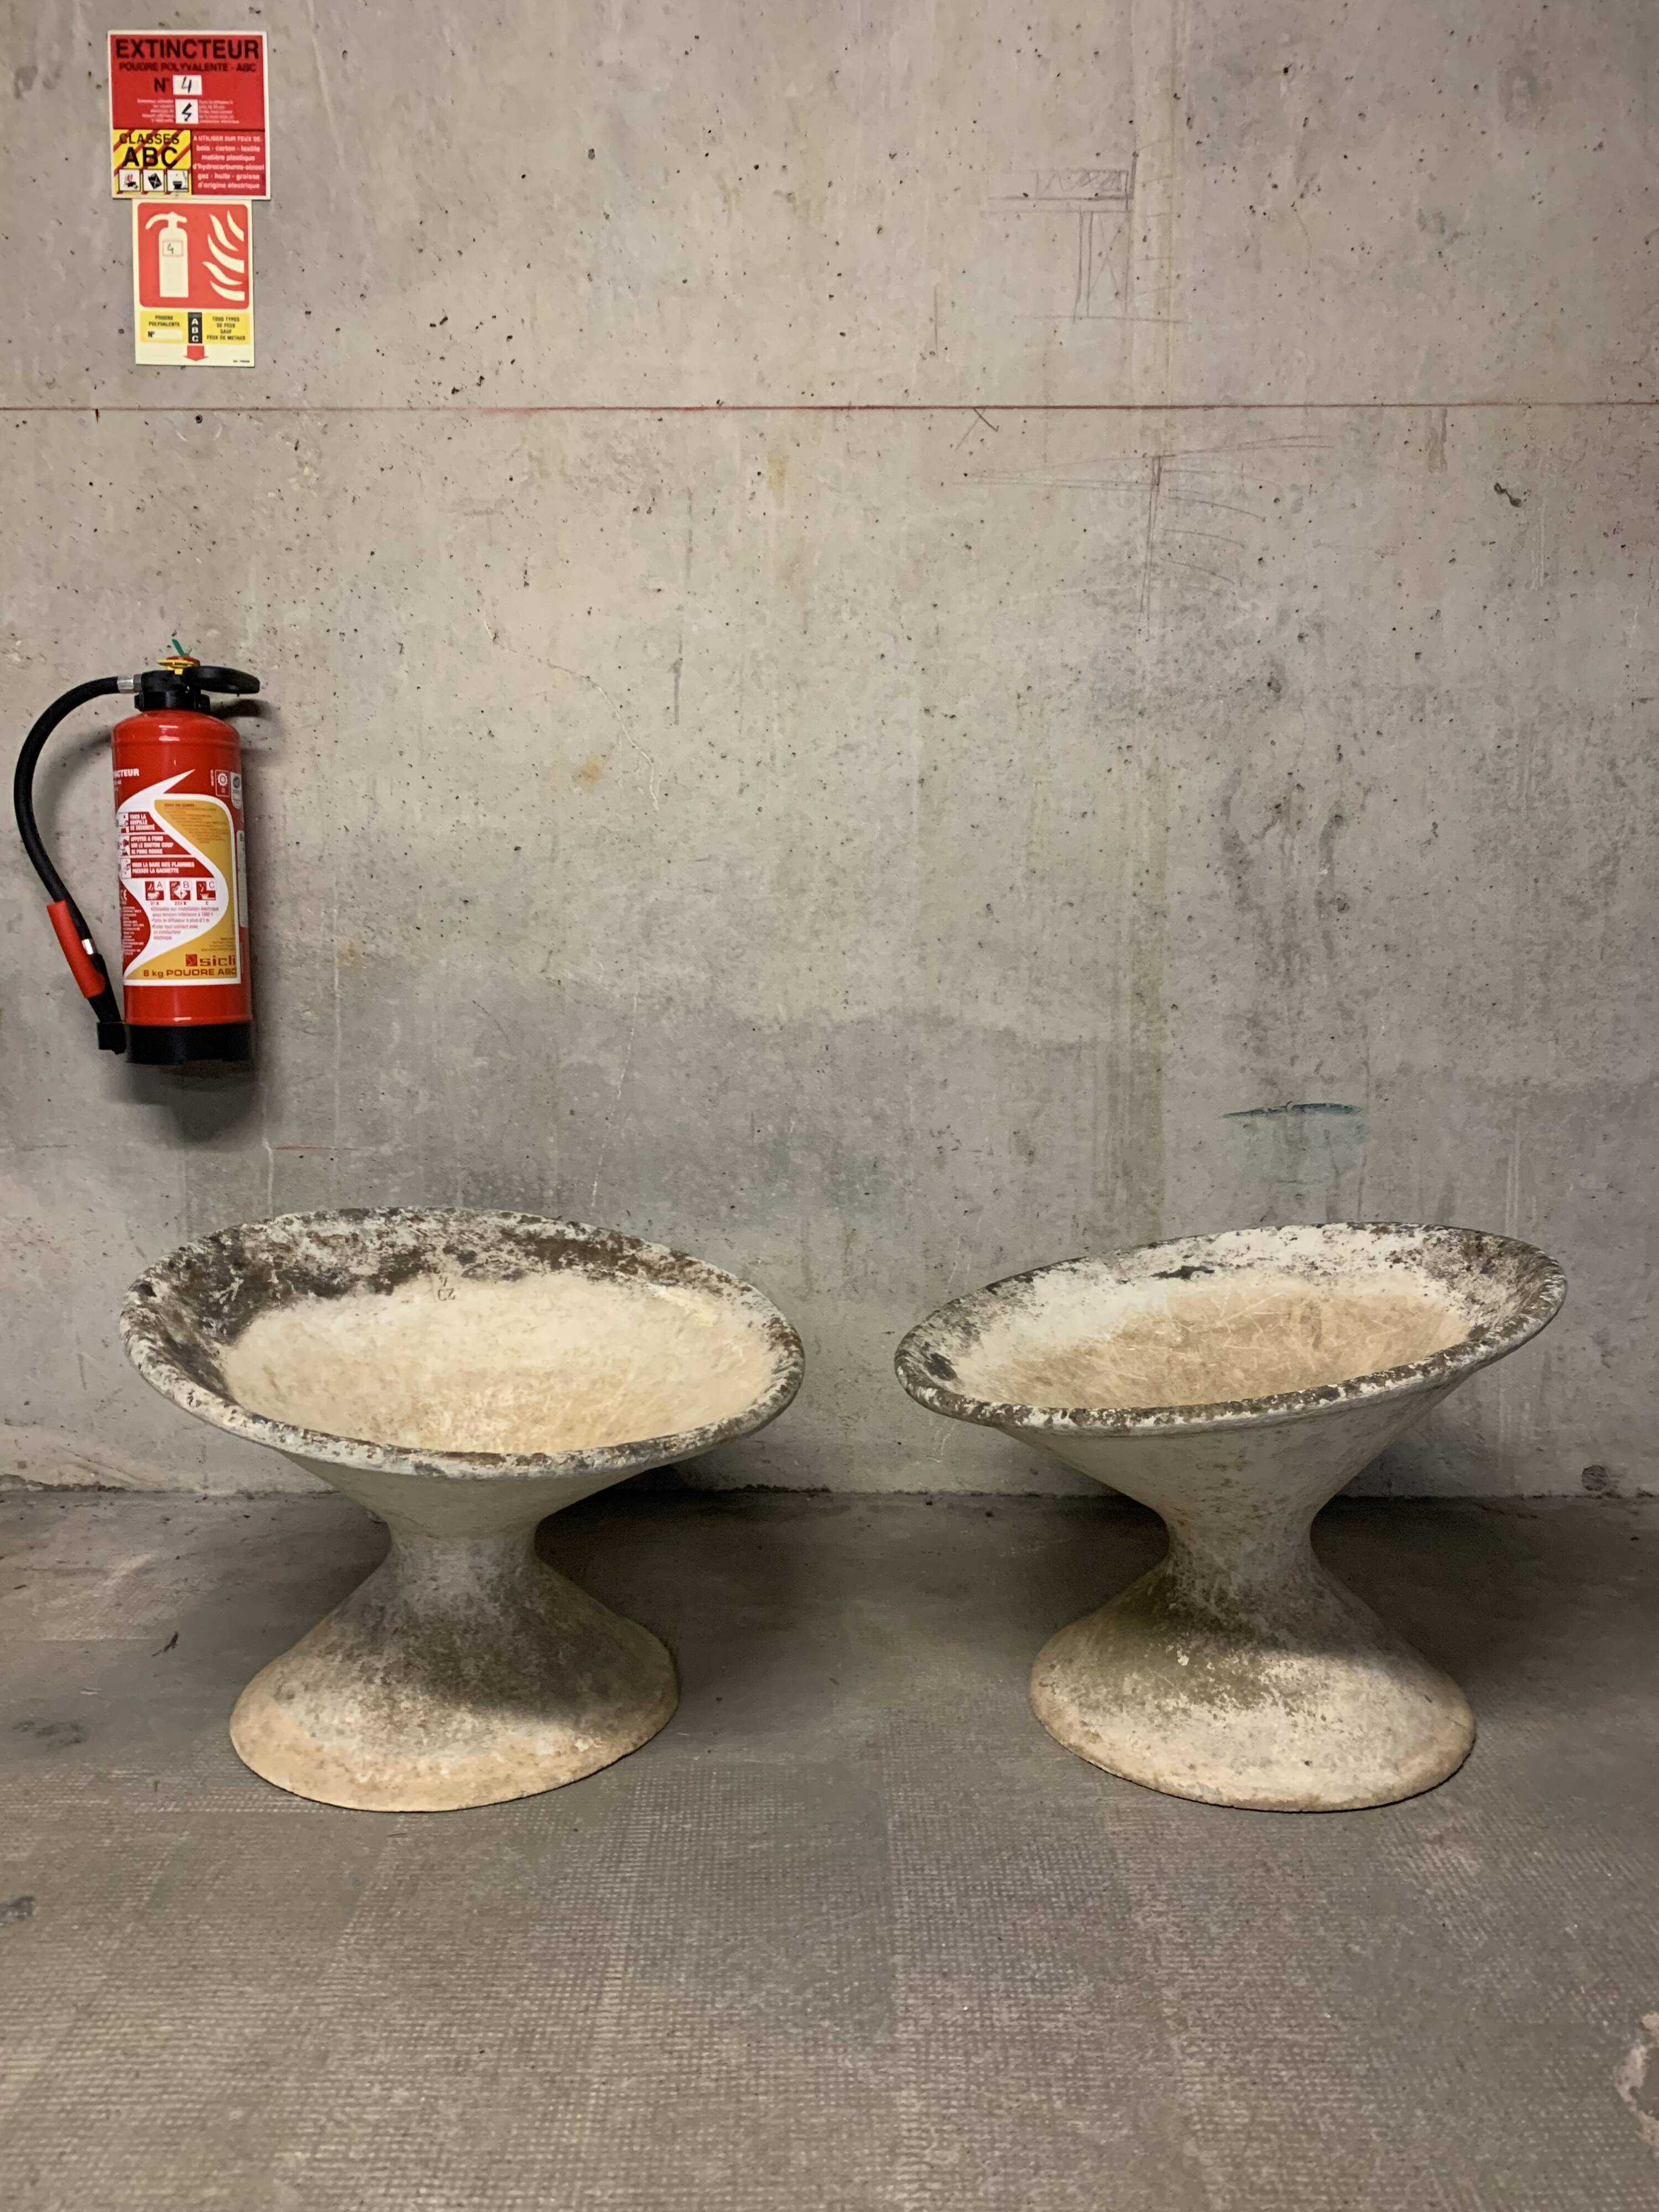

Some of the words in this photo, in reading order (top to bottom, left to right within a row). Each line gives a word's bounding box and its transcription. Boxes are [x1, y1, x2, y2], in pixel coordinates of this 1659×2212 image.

[116, 39, 259, 59] EXTINCTEUR
[119, 62, 158, 71] POUDRE
[161, 62, 228, 72] POLYVALENTE
[236, 64, 256, 72] ABC
[181, 76, 192, 93] 4
[119, 133, 179, 144] CLASSES
[122, 147, 178, 167] ABC
[209, 880, 215, 889] C
[200, 954, 236, 967] sicli
[152, 970, 164, 979] kg
[166, 968, 215, 977] POUDRE
